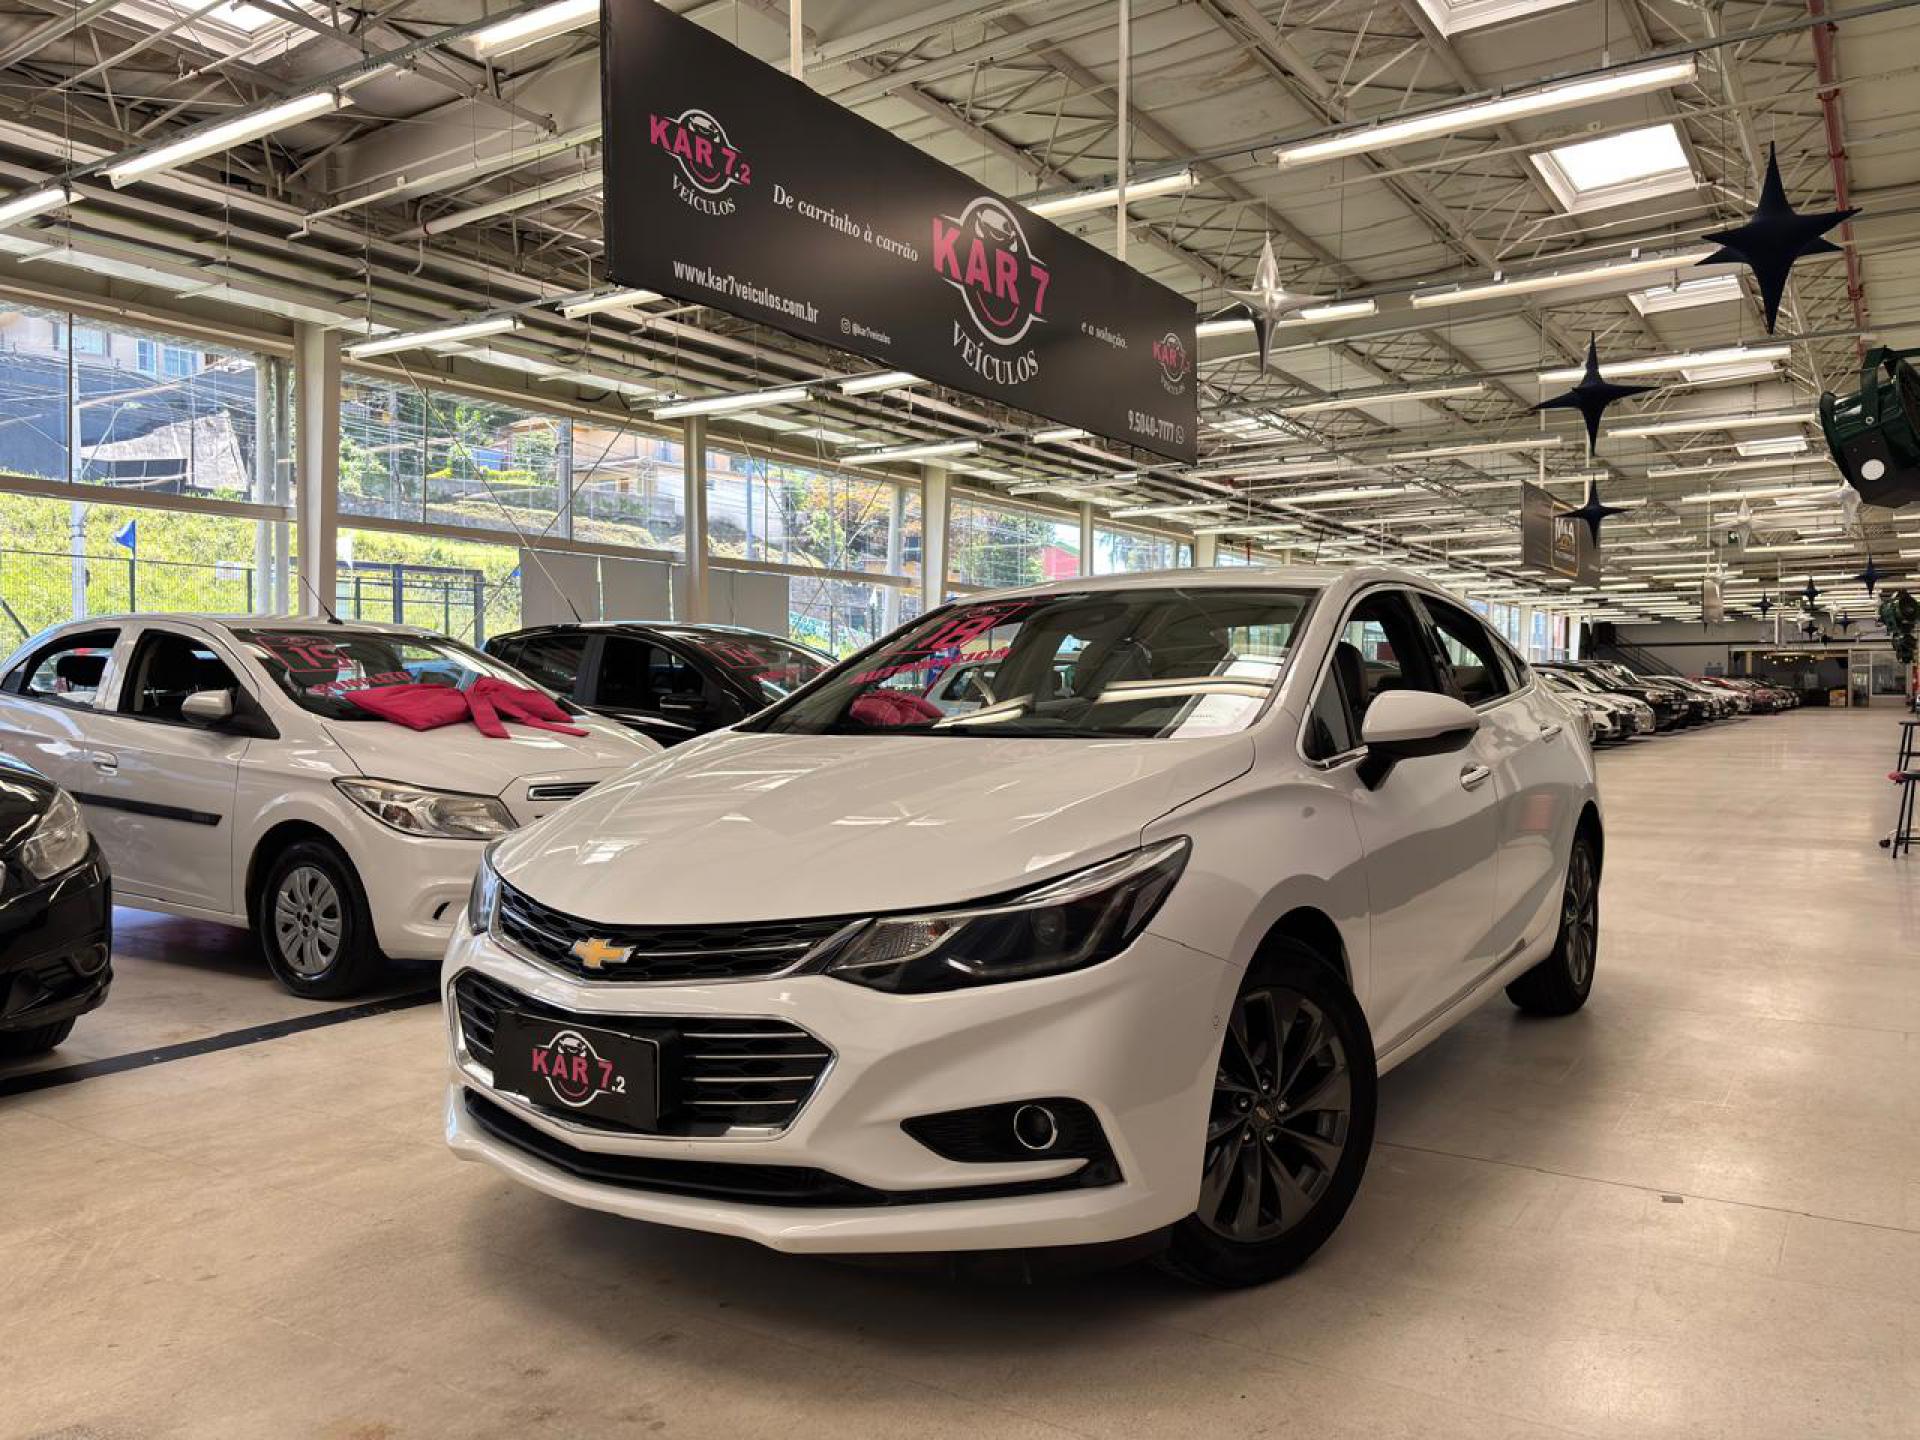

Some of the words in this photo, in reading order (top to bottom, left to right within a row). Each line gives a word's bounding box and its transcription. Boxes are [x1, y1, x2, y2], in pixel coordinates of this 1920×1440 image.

[650, 113, 714, 169] KAR
[721, 147, 751, 185] 7.2
[673, 172, 736, 216] VEÍCULOS
[773, 184, 795, 209] De
[797, 200, 861, 238] carrinho
[863, 223, 874, 244] à
[876, 234, 919, 262] carrão
[673, 260, 819, 324] www.kar7veiculos.com.br
[932, 216, 1020, 305] KAR
[1030, 264, 1051, 314] 7
[953, 320, 1039, 385] VEÍCULOS
[1088, 325, 1095, 336] a
[1152, 340, 1177, 368] KAR
[916, 616, 997, 650] 18
[531, 1048, 589, 1086] KAR
[598, 1060, 626, 1093] 7.2
